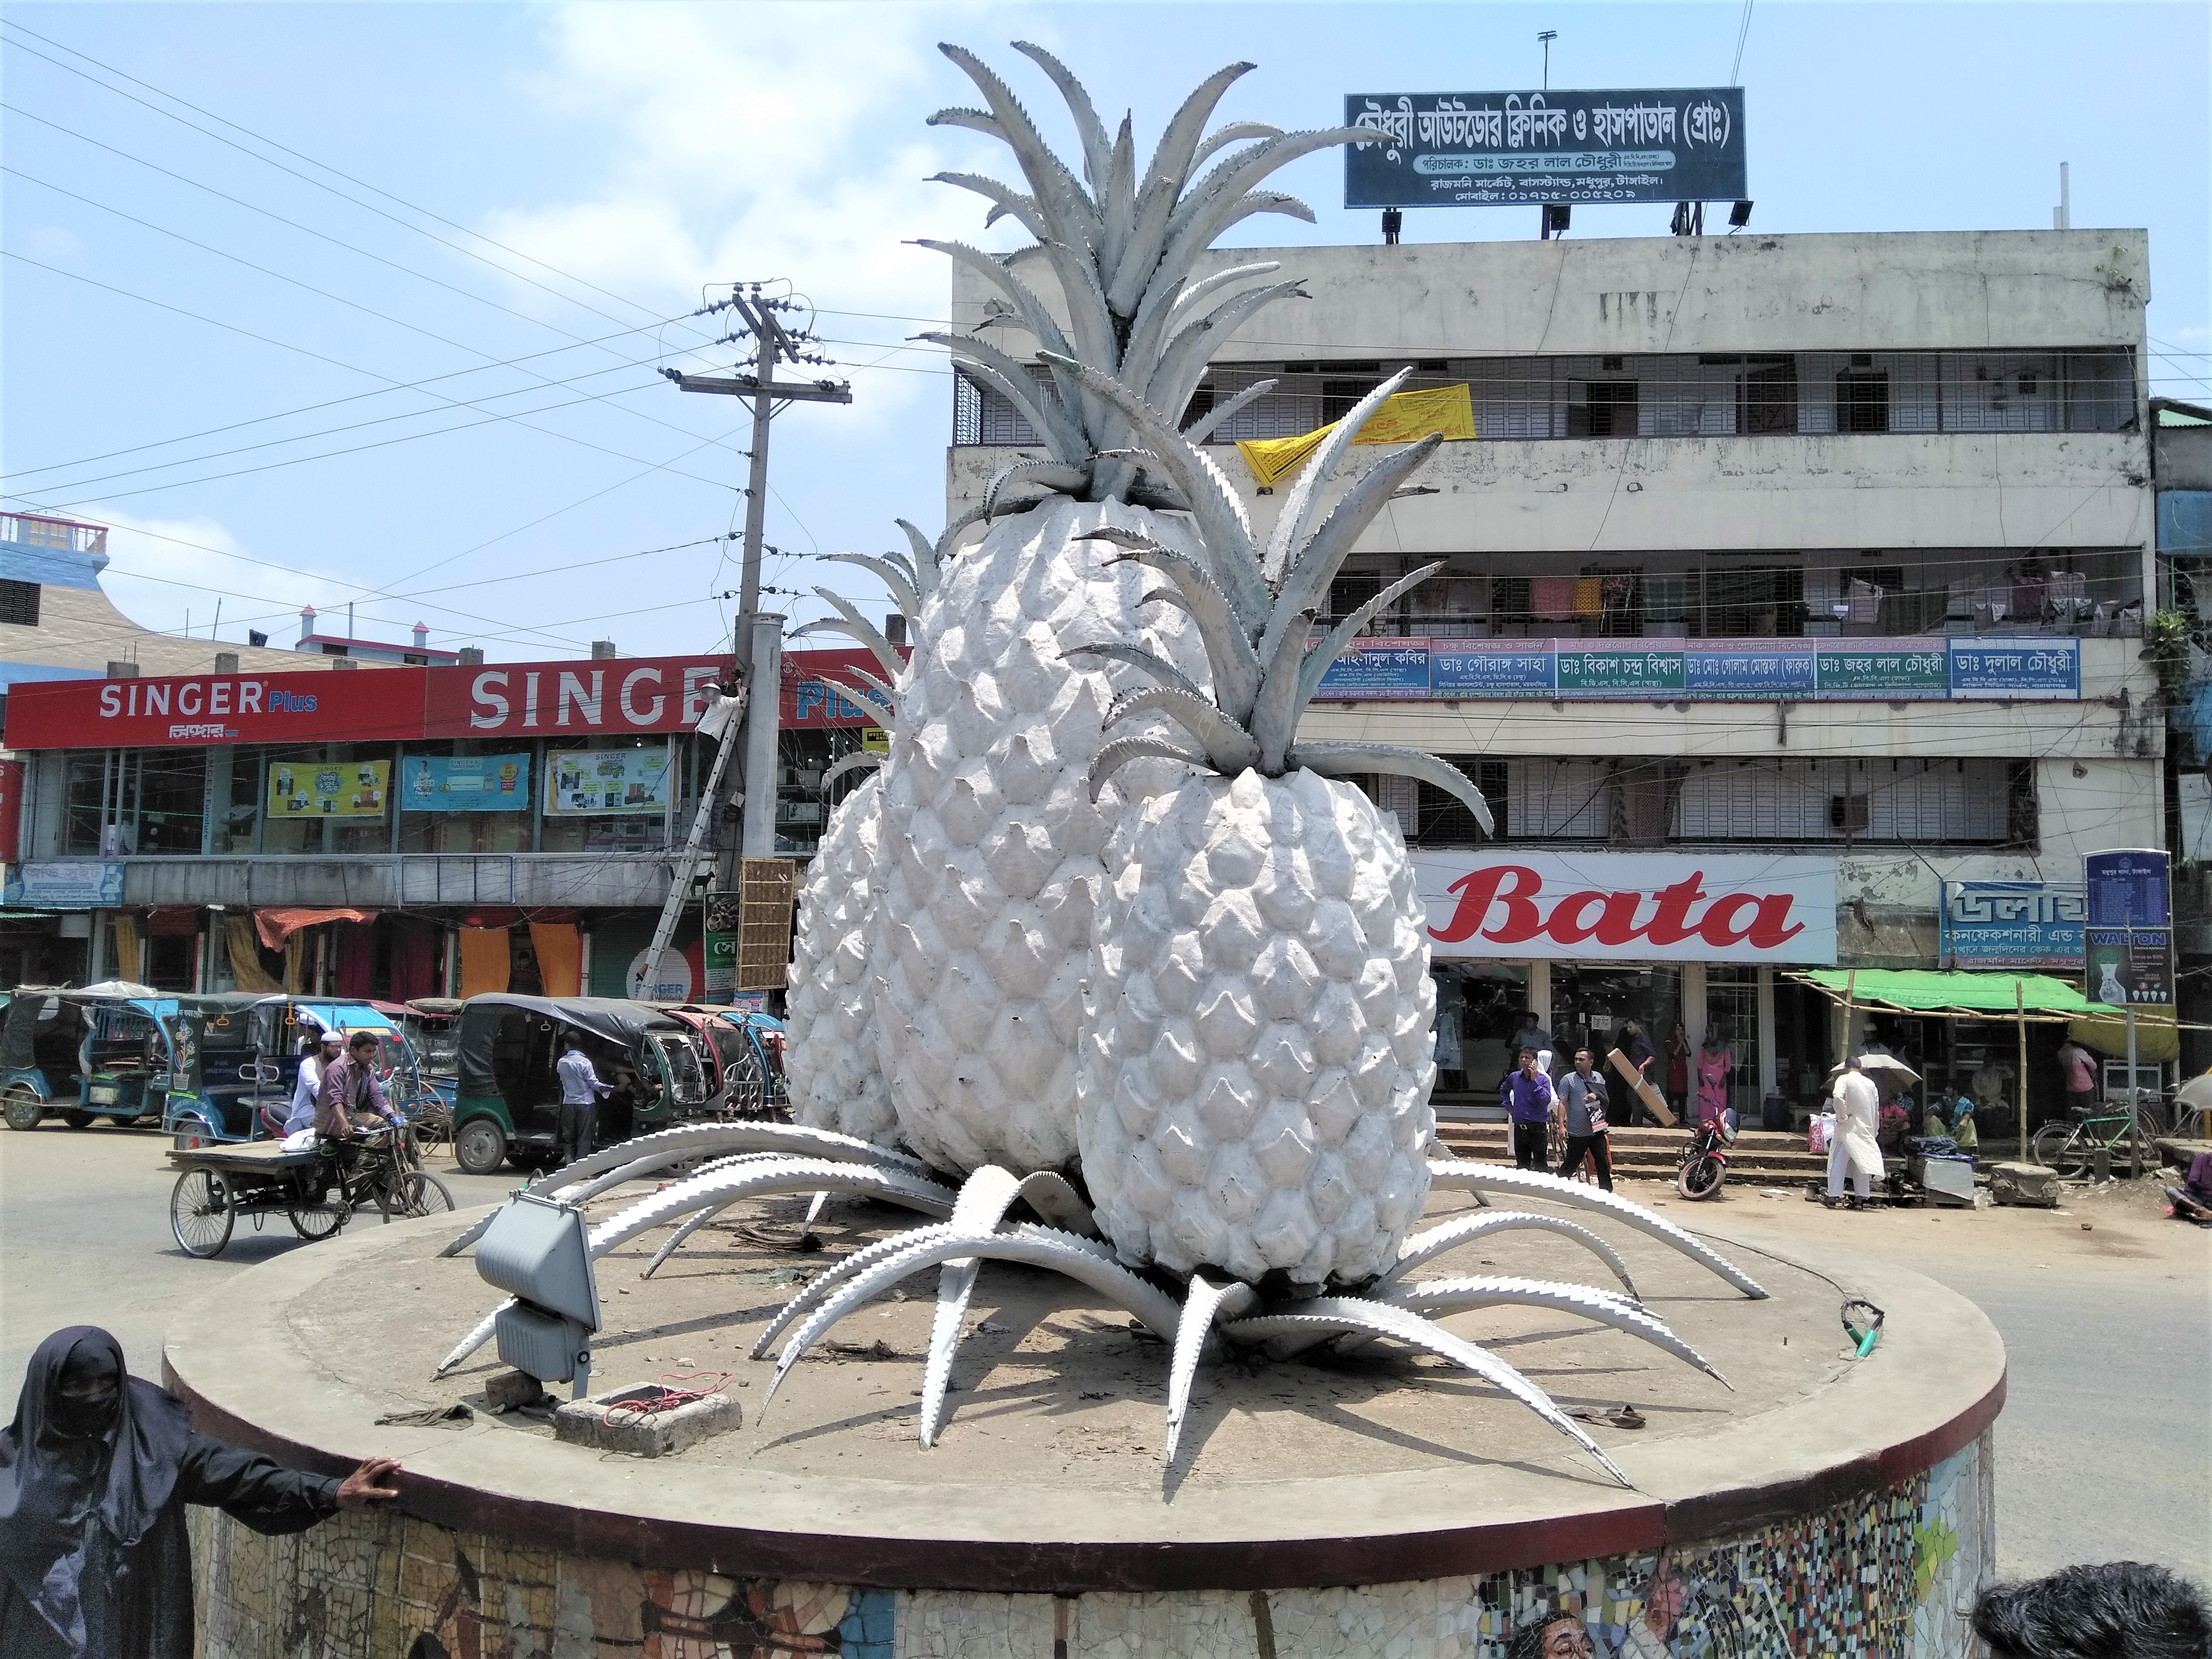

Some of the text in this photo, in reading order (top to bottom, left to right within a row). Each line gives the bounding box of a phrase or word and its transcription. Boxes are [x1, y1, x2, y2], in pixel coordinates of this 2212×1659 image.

[1418, 96, 1502, 149] আউটডোর
[1505, 93, 1566, 148] ক্লিনিক
[1573, 109, 1586, 140] ও
[1592, 100, 1677, 147] হাসপাতাল
[1473, 157, 1493, 170] ডাঃ
[1498, 158, 1539, 170] জহর
[1544, 156, 1571, 167] লাল
[1575, 152, 1622, 171] চৌধুরী
[1430, 176, 1472, 190] রাজমনি
[1443, 642, 1460, 651] চক্ষু
[1463, 641, 1501, 650] বিশেষজ্ঞ
[1516, 640, 1543, 649] সার্জন
[1636, 640, 1672, 649] বিশেষজ্ঞ
[1779, 640, 1811, 649] বিশেষজ্ঞ
[1394, 649, 1427, 665] কবির
[1439, 655, 1547, 673] ডাঃ গৌরাঙ্গ সাহা
[1560, 653, 1682, 677] ডাঃ বিকাশ চন্দ্র বিশ্বাস
[1819, 652, 1943, 676] ডাঃ জহর লাল চৌধুরী
[1955, 650, 2072, 676] ডাঃ দুলাল চৌধুরী
[1687, 656, 1813, 680] ডাঃ মোঃ গোলাম মোস্তফা (ফারুক)
[100, 681, 318, 717] SINGER Plus
[470, 666, 783, 729] SINGE
[1427, 866, 1806, 948] Bata
[2048, 929, 2073, 943] এন্ড
[2090, 933, 2166, 945] WALTON
[2031, 945, 2051, 954] কেক
